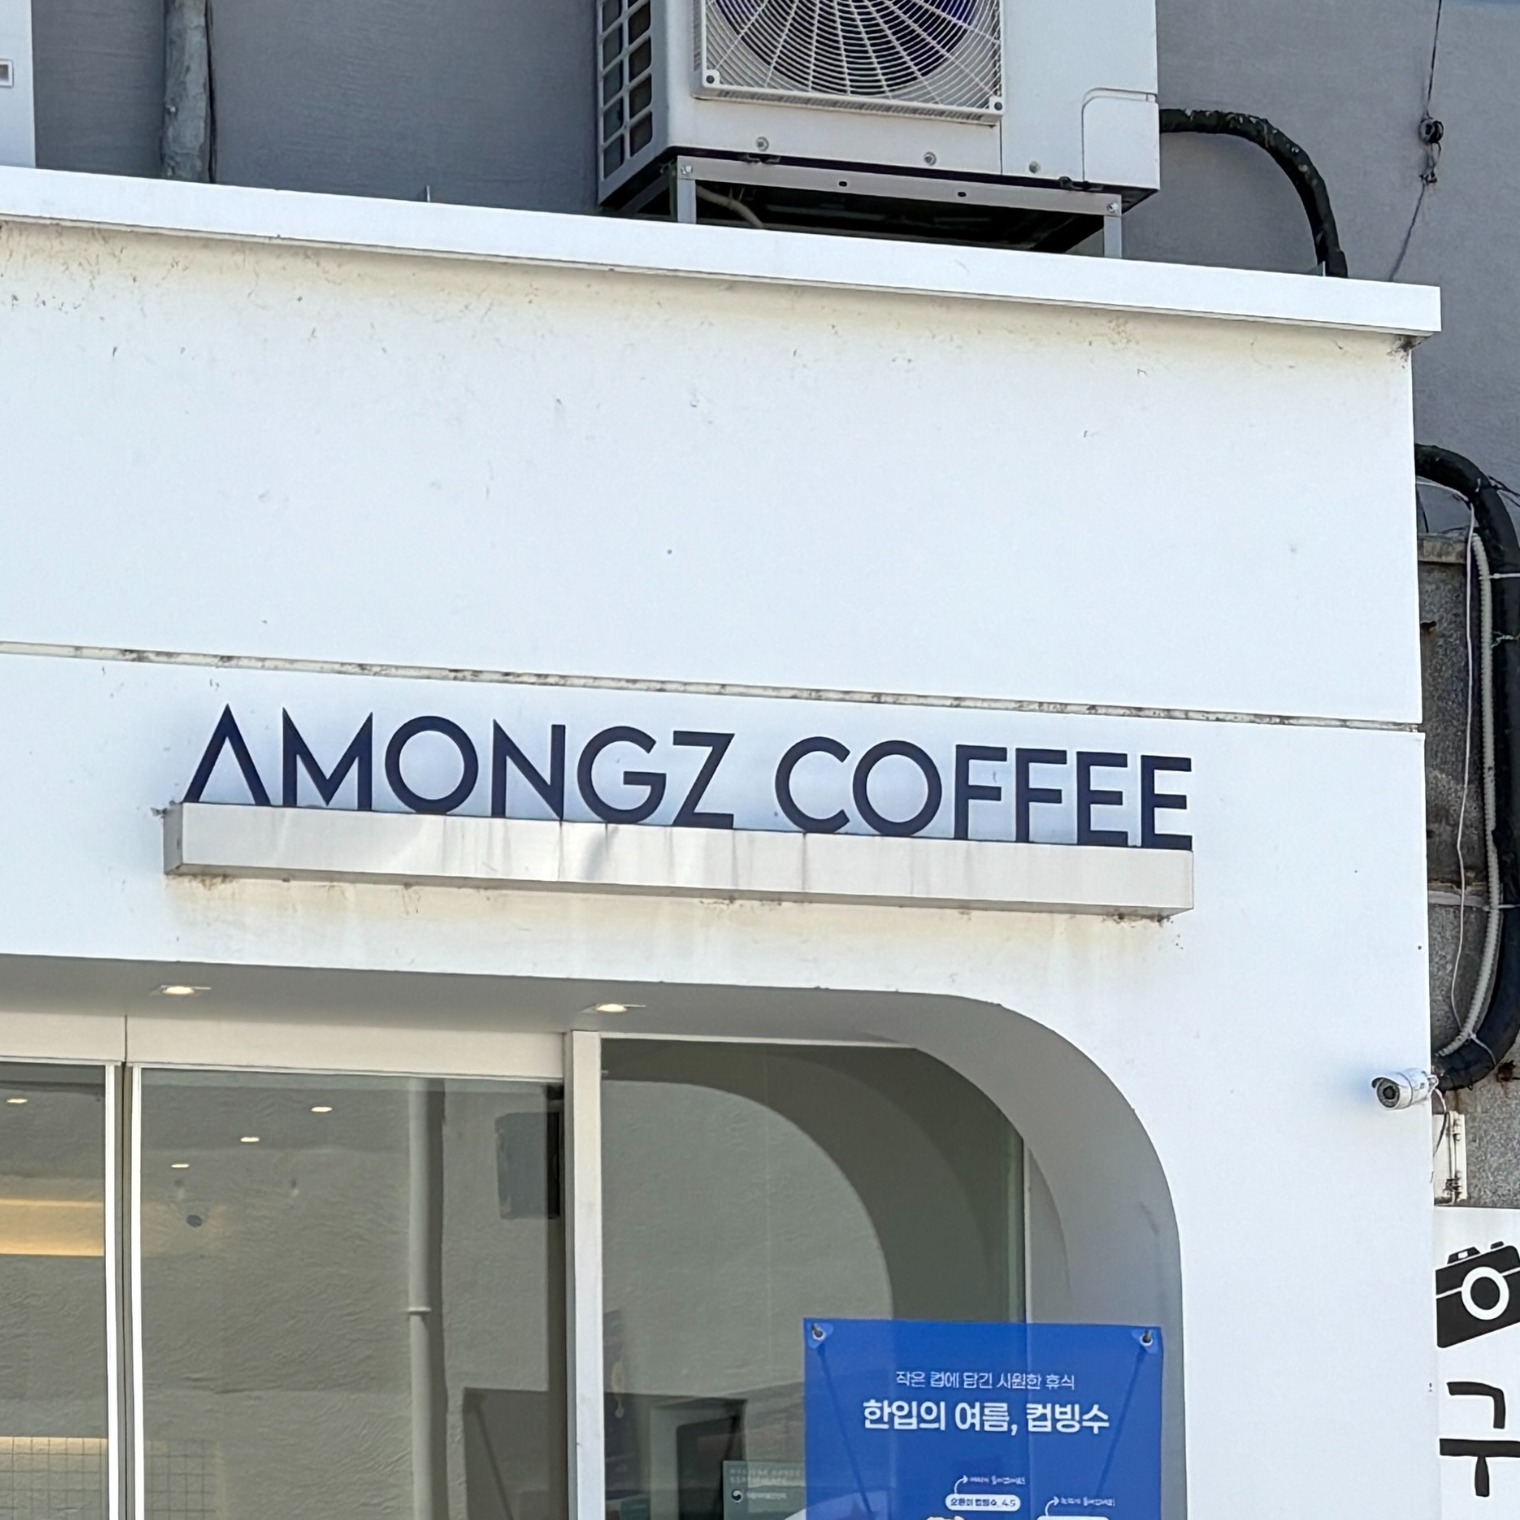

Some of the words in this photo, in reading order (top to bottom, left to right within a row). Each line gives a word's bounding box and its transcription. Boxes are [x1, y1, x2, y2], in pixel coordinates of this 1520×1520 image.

[183, 702, 735, 829] AMONGZ
[776, 735, 1193, 851] COFFEE
[896, 1371, 925, 1387] 작은
[930, 1371, 959, 1388] 컵에
[963, 1372, 993, 1389] 담긴
[996, 1372, 1041, 1390] 시원한
[1045, 1374, 1075, 1390] 휴식
[862, 1399, 946, 1432] 한입의
[954, 1401, 1018, 1436] 여름,
[1026, 1403, 1110, 1434] 컵빙수
